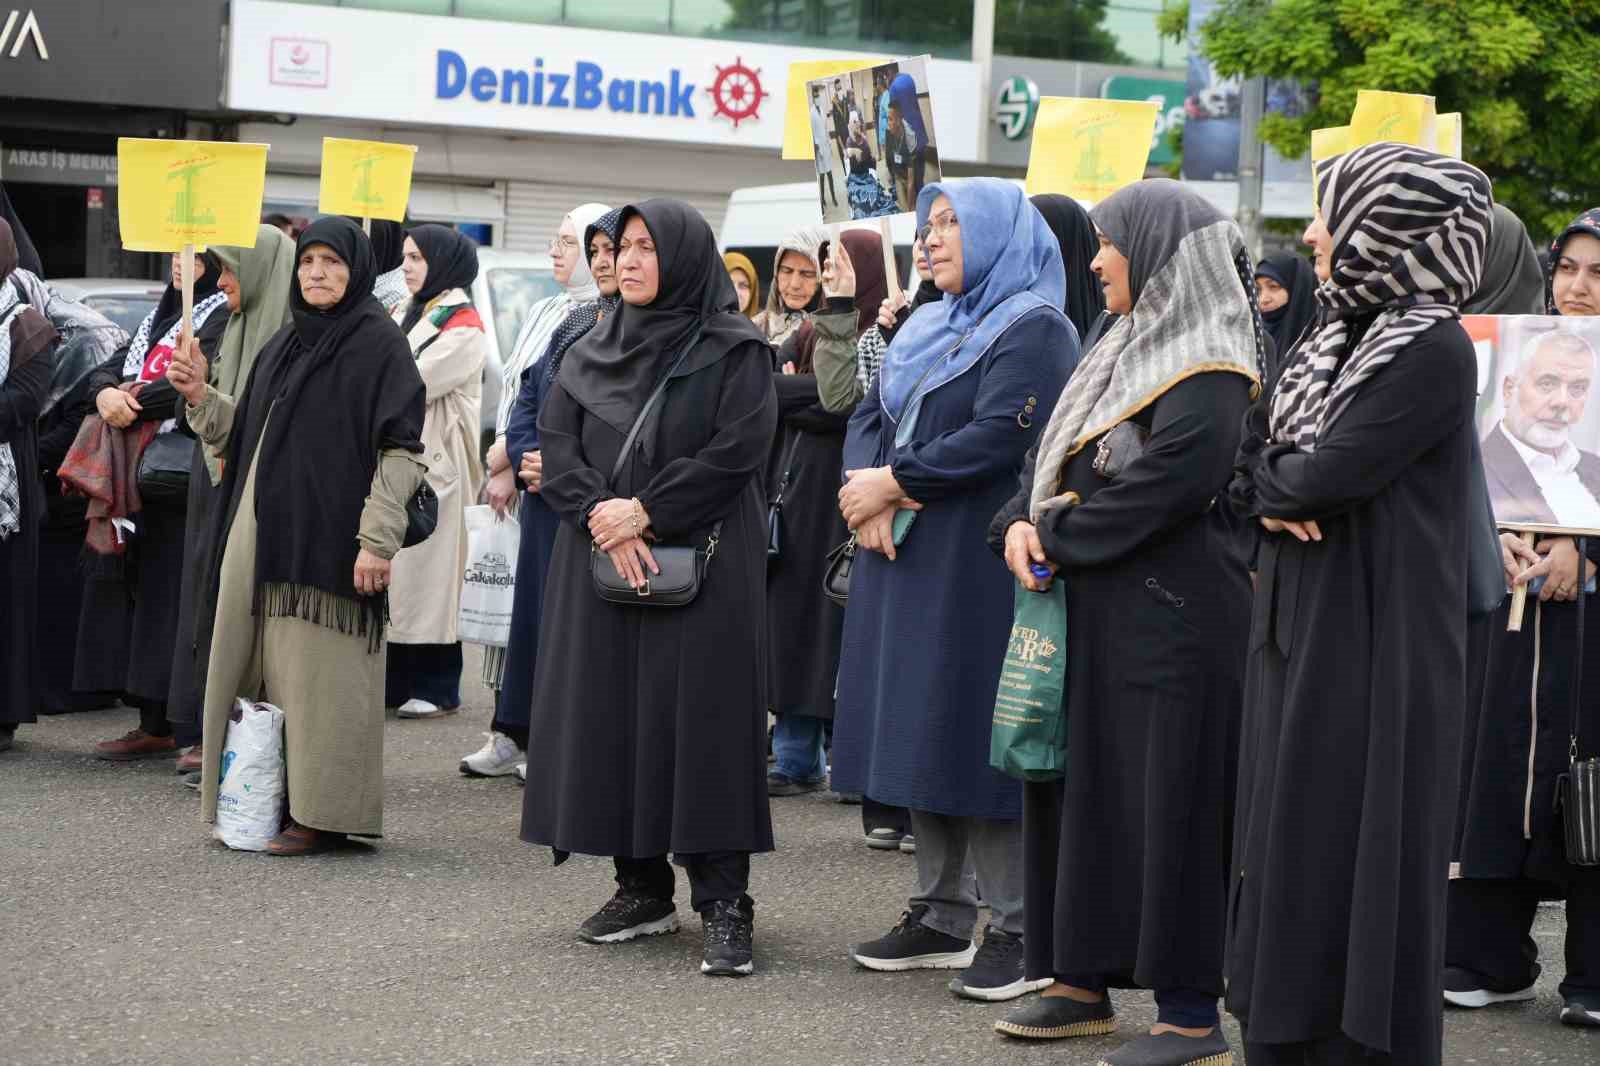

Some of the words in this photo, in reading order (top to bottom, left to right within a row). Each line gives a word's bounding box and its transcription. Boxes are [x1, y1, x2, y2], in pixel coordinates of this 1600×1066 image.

[433, 49, 695, 117] DenizBank
[8, 147, 48, 168] ARAS
[52, 147, 65, 171] İŞ
